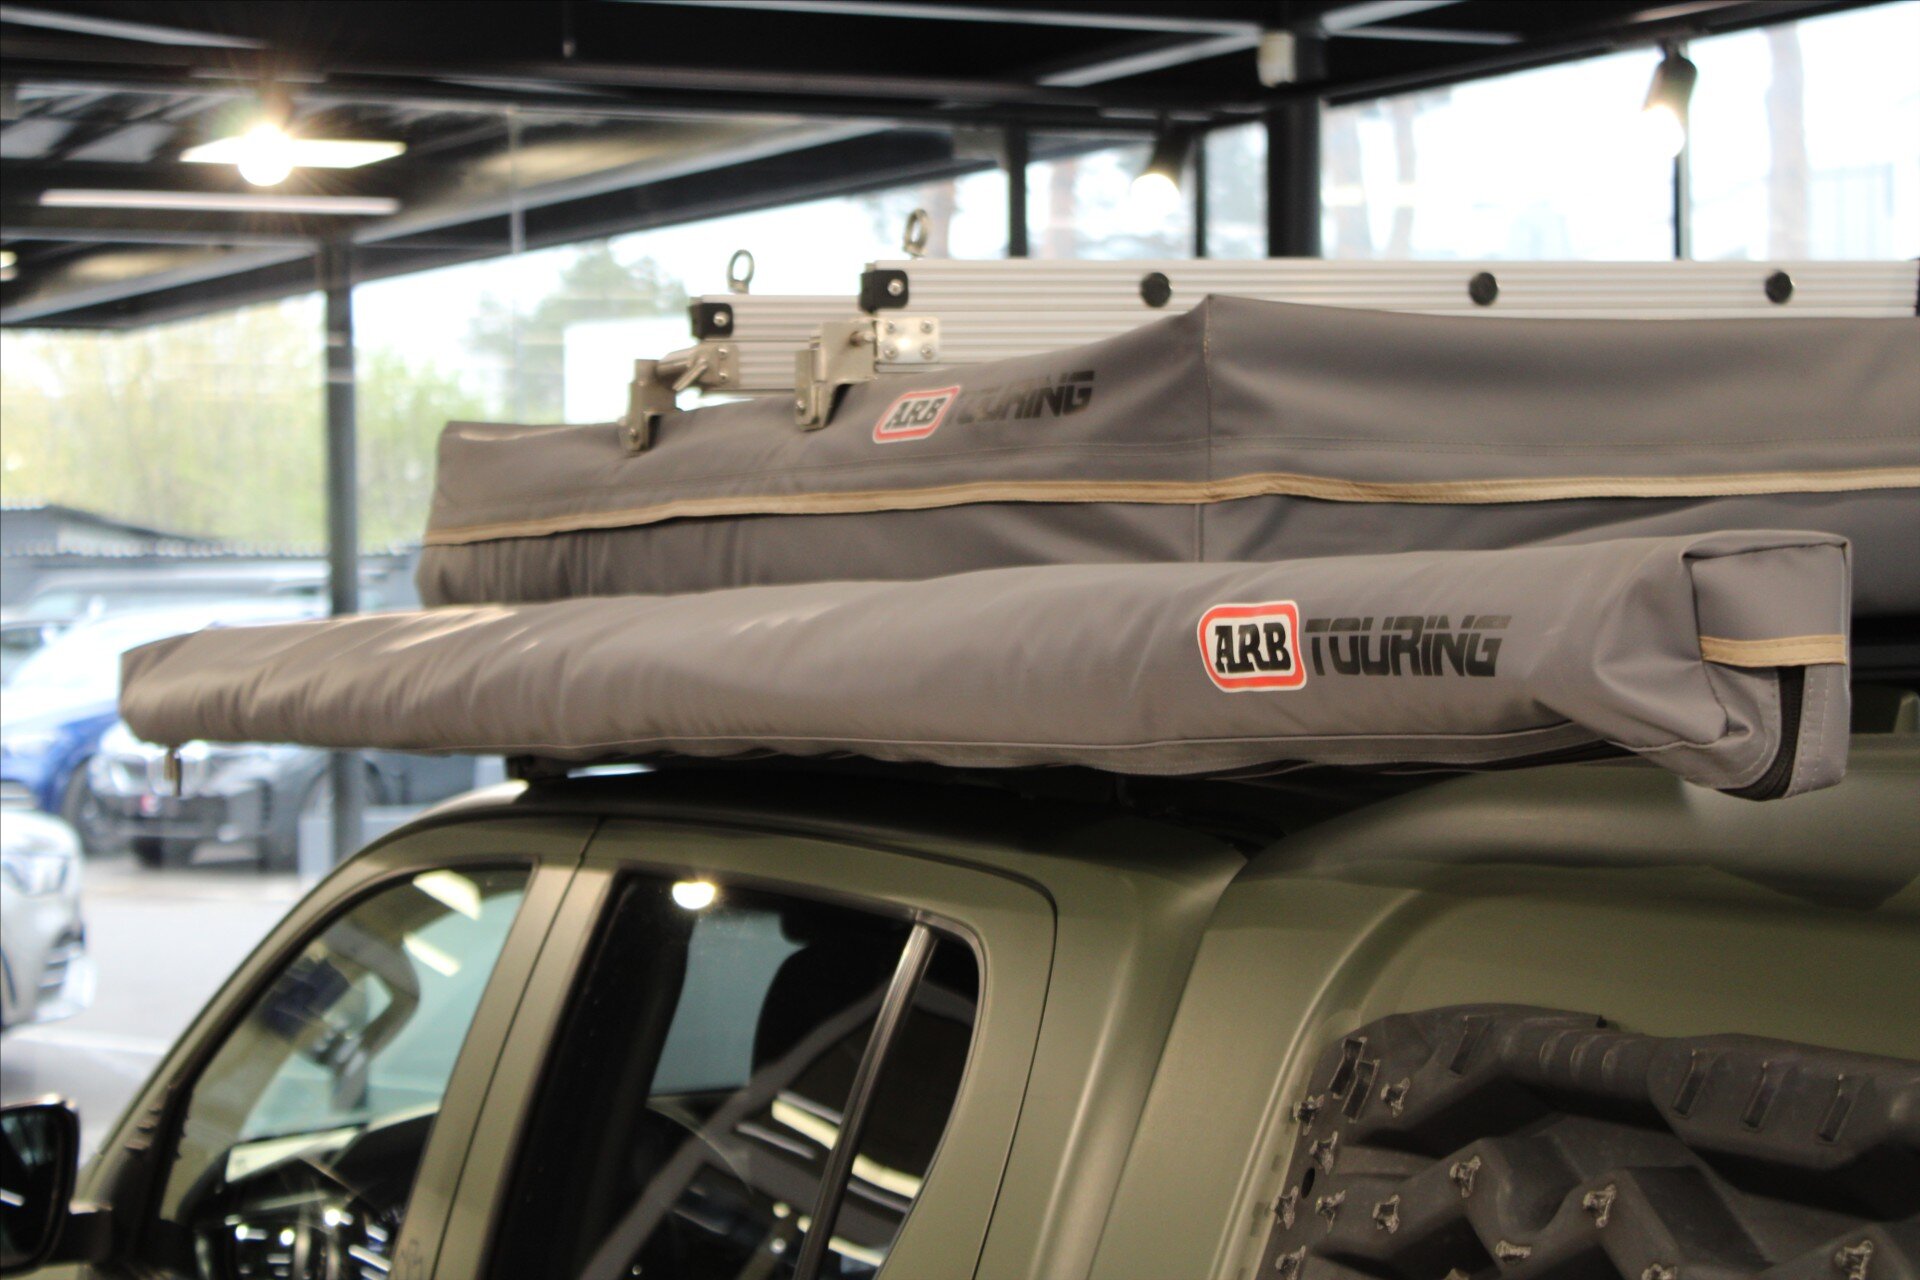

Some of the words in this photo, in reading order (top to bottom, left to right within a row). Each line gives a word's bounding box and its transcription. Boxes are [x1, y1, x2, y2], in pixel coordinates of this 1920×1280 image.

[885, 397, 947, 431] ARB
[1215, 622, 1292, 674] ARB
[1304, 615, 1512, 677] TOURING
